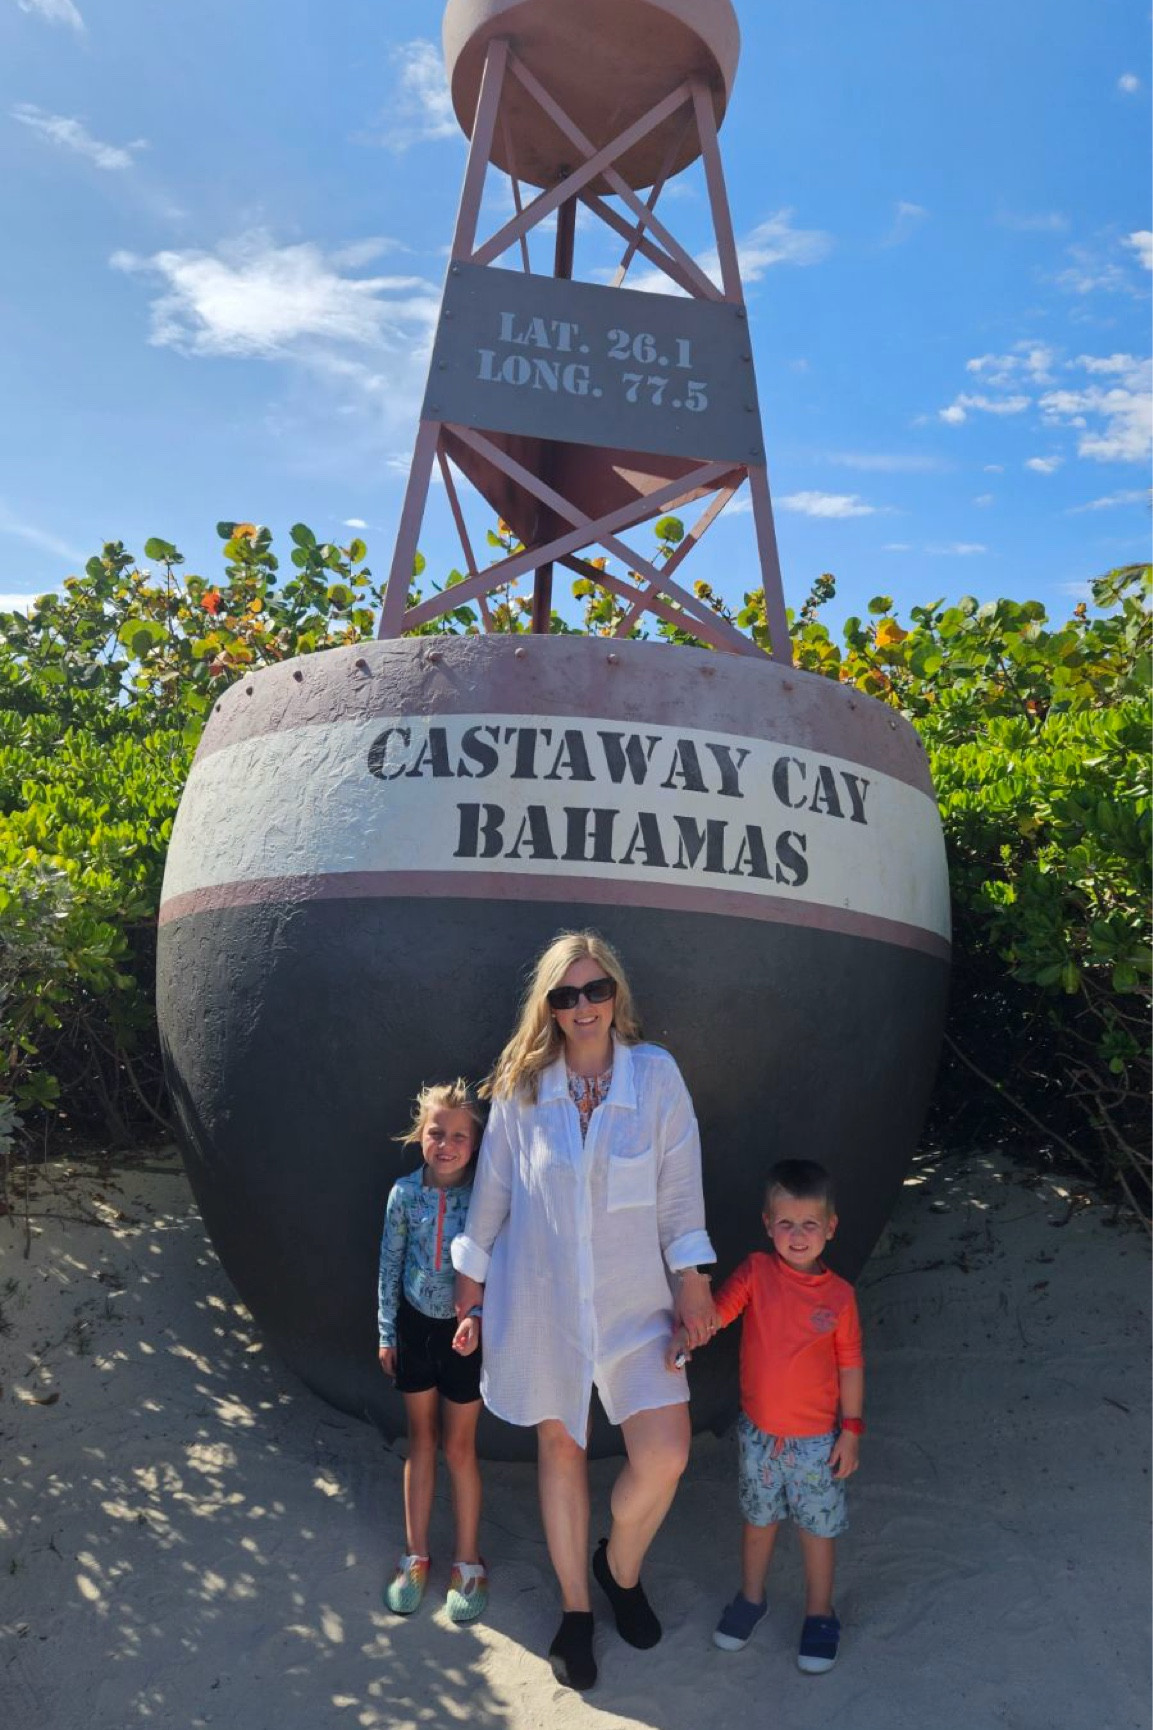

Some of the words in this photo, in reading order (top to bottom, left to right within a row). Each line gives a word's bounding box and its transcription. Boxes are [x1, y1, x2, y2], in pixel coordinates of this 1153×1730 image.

[498, 311, 590, 353] LAT.
[607, 328, 693, 369] 26.1
[476, 349, 603, 398] LONG.
[622, 372, 708, 412] 77.5
[366, 725, 751, 799] CASTAWAY
[772, 756, 870, 825] CAY
[453, 802, 809, 887] BAHAMAS
